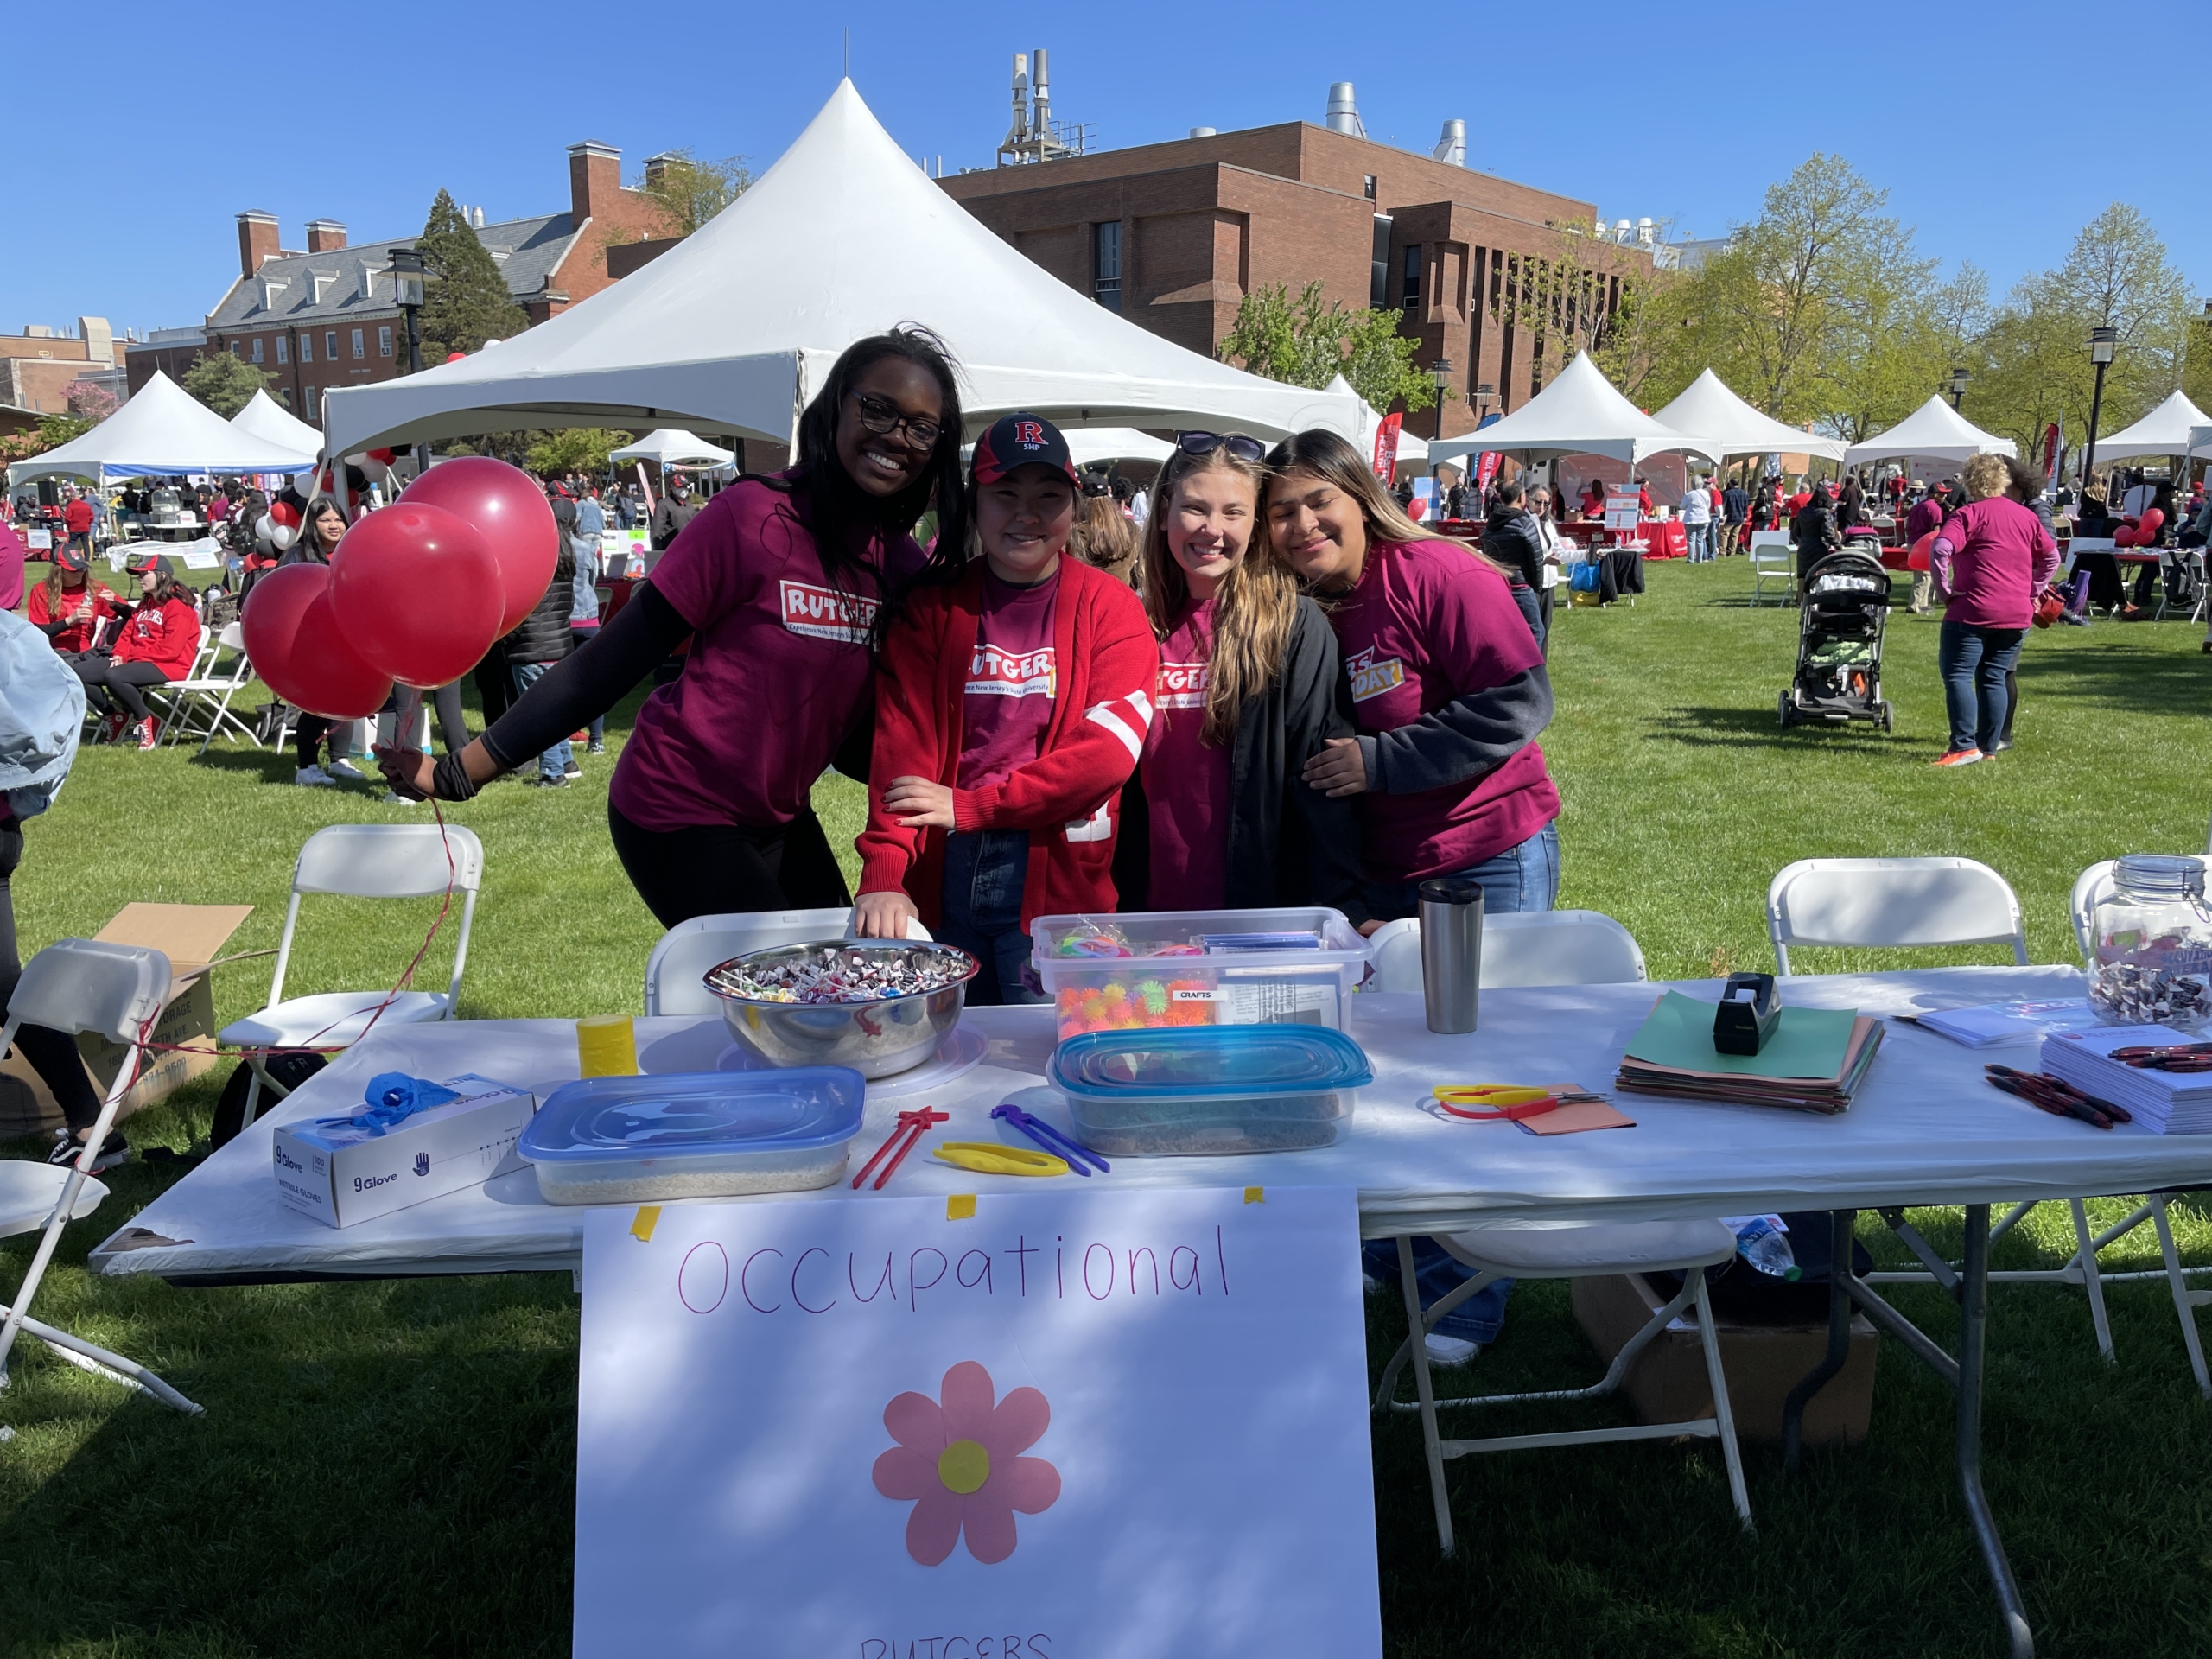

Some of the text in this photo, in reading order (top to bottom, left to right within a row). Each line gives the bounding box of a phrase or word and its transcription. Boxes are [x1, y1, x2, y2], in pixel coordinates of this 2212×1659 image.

[1015, 421, 1046, 443] R
[1377, 435, 1387, 469] HEALTH
[1480, 470, 1491, 497] ealth
[787, 589, 877, 626] RUTGER
[789, 623, 817, 634] Experience
[817, 627, 828, 636] New
[968, 652, 1055, 679] UTGER
[1356, 666, 1395, 695] DAY
[158, 1001, 192, 1027] TORAGE
[174, 1024, 189, 1039] AVE.
[278, 1178, 300, 1194] NITRILE
[299, 1188, 322, 1205] GLOVES
